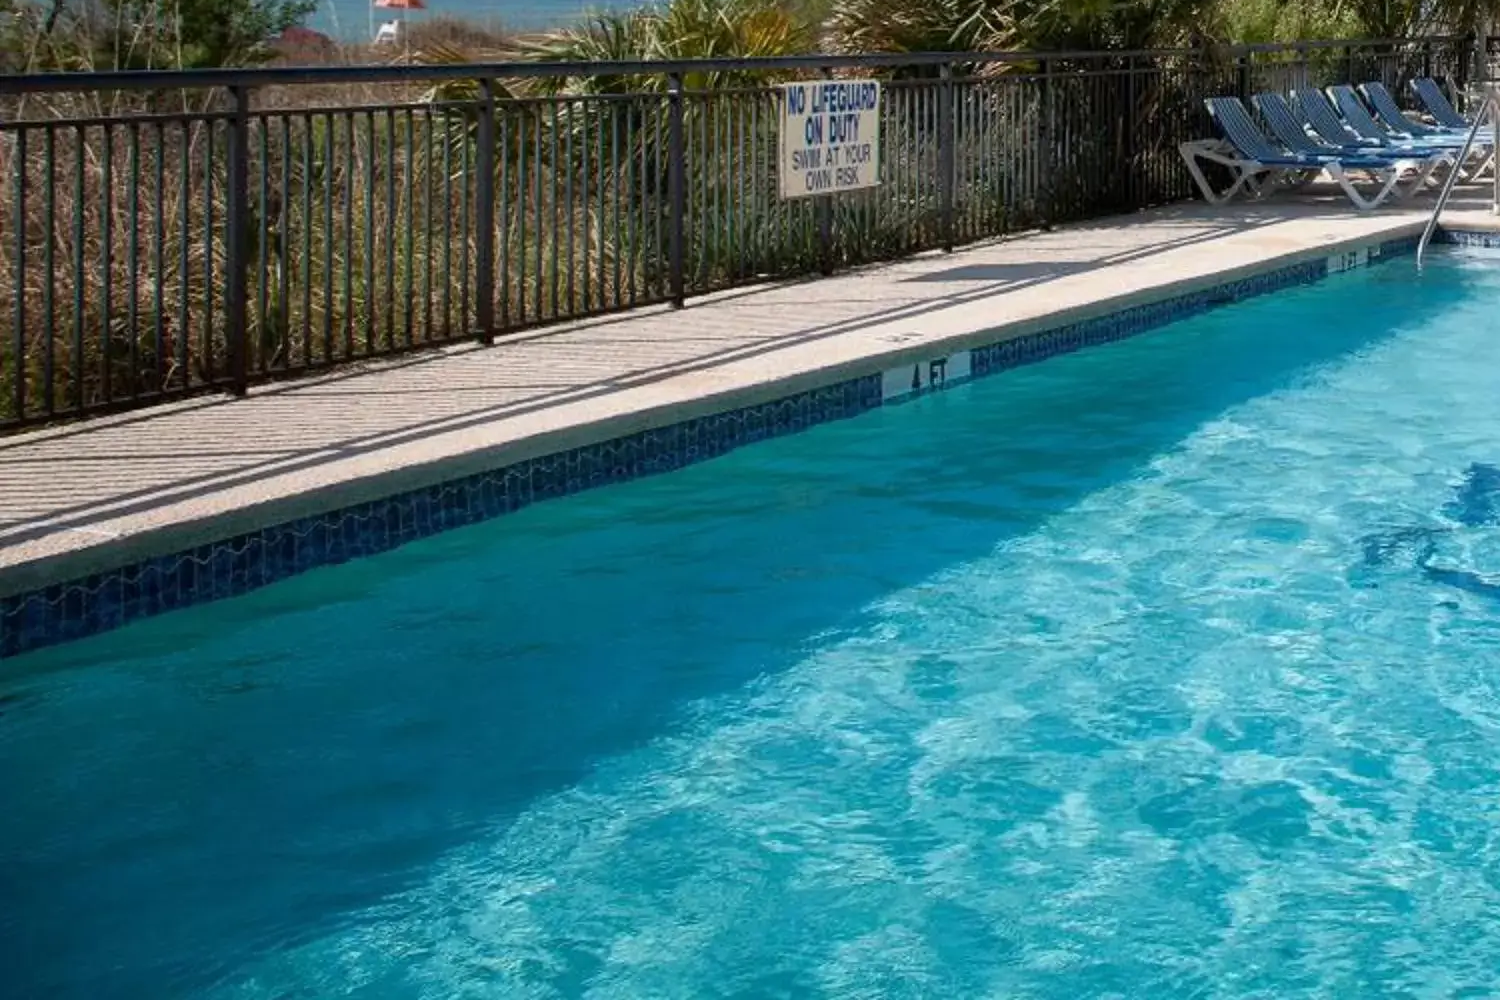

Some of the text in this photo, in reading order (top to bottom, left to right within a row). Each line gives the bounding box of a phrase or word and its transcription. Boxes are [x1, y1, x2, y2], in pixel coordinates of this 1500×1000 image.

[788, 82, 877, 115] NO LIFEGUARD
[805, 114, 860, 145] ON DUTY
[792, 144, 871, 170] SWIM AT YOUR
[805, 167, 860, 191] OWN RISK
[930, 359, 948, 391] FT
